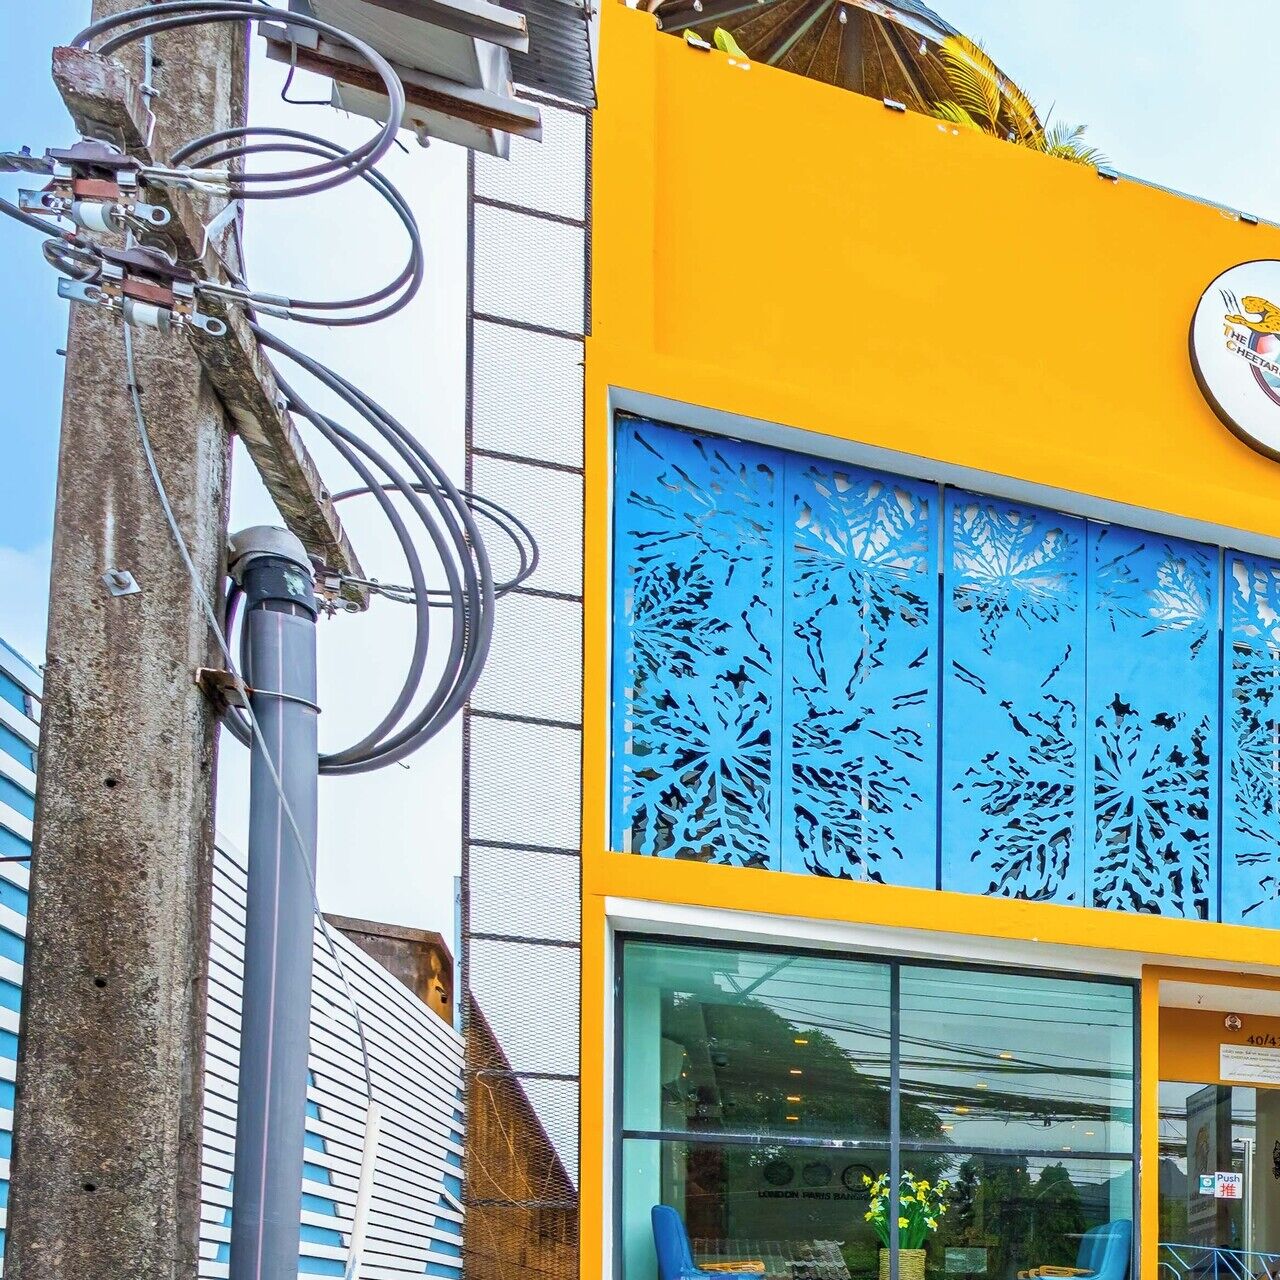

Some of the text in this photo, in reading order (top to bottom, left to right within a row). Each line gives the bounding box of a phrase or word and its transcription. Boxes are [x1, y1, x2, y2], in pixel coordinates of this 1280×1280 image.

[1222, 323, 1248, 346] THE
[1217, 1174, 1240, 1183] Push
[1220, 1183, 1236, 1197] 推
